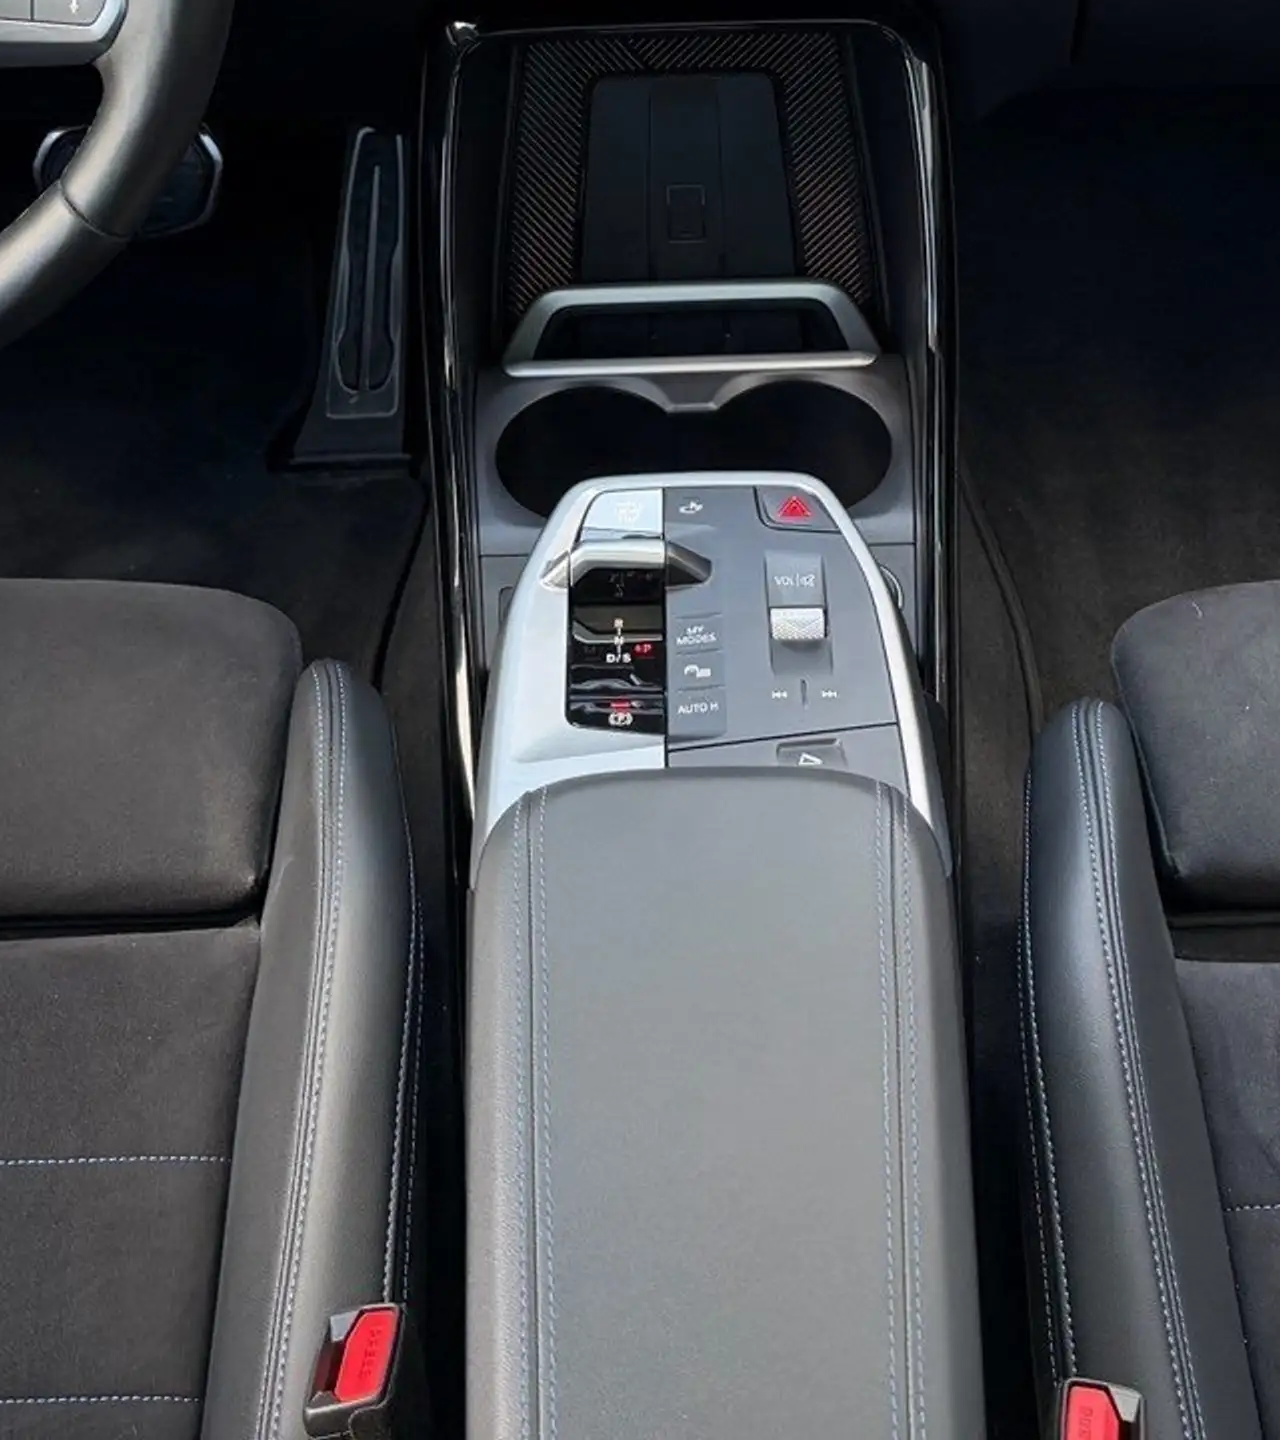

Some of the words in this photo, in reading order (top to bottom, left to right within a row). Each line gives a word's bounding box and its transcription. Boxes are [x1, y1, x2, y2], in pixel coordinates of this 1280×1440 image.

[676, 631, 718, 646] MODES
[677, 701, 708, 715] AUTO
[709, 700, 720, 712] H
